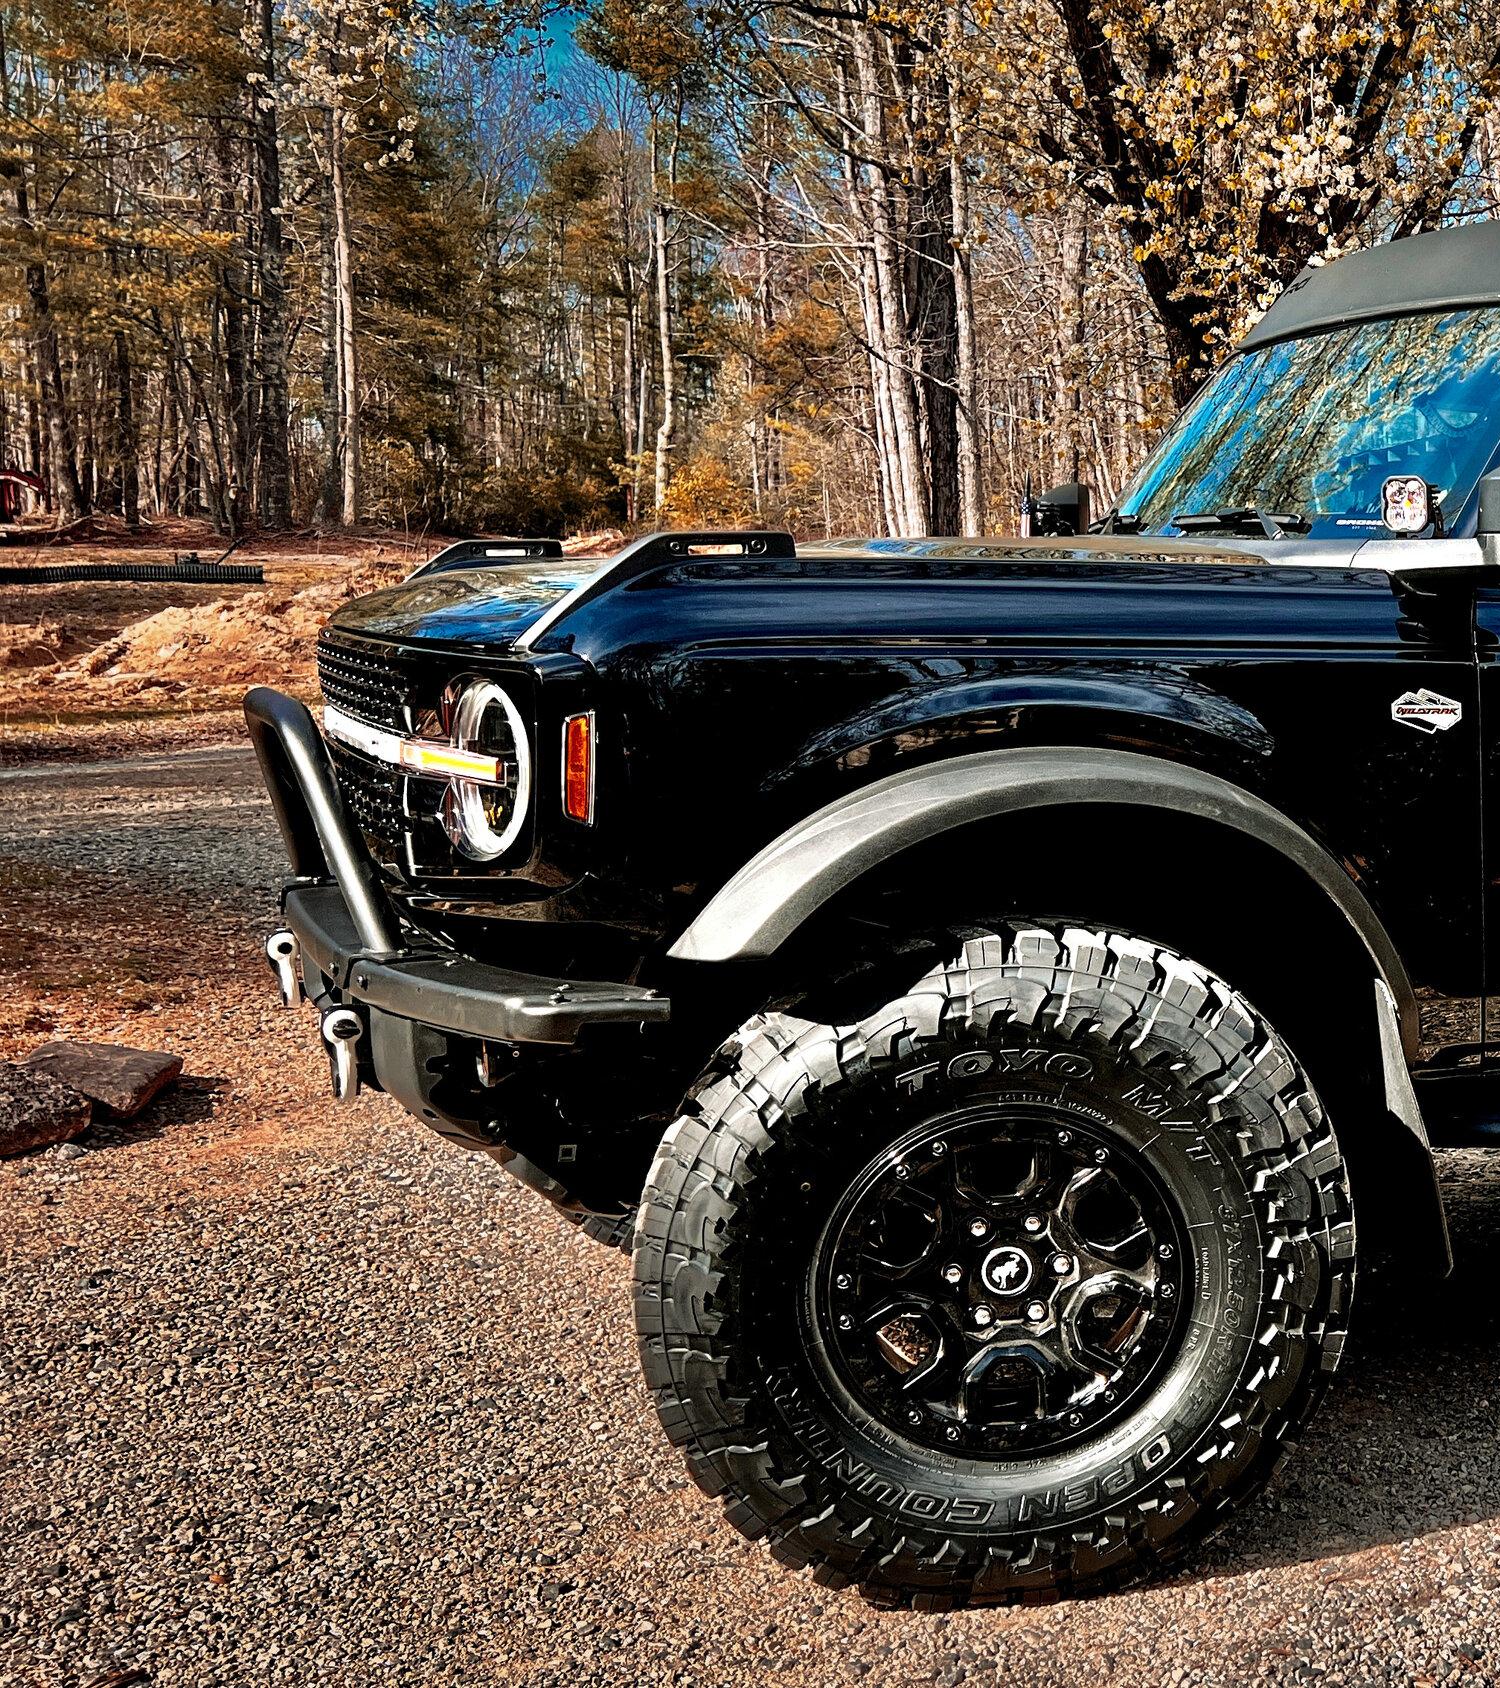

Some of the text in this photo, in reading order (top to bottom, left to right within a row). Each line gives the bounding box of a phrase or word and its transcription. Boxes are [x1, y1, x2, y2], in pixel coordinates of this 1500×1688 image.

[1396, 706, 1460, 716] WILDTRAK
[895, 1049, 1093, 1097] TOYO
[1018, 1429, 1171, 1522] OPEN
